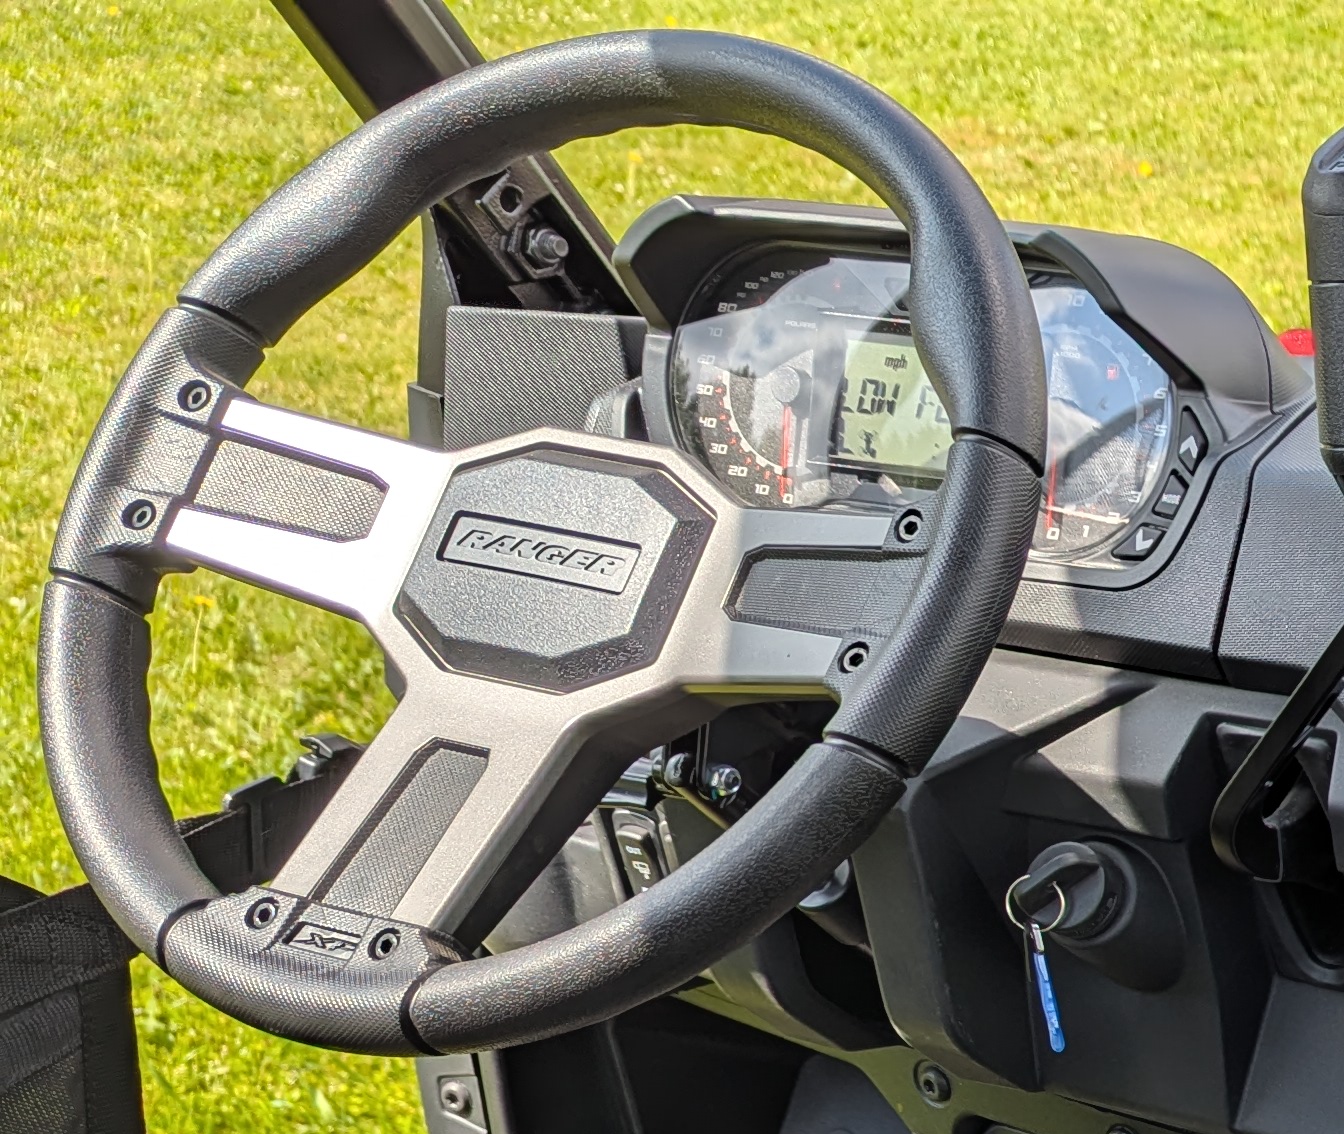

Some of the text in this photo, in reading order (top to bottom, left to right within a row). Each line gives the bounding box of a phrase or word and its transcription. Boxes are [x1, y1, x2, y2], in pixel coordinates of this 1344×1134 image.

[770, 271, 784, 279] 120
[744, 281, 760, 290] 100
[1066, 294, 1085, 307] 10
[717, 302, 737, 313] 80
[785, 320, 816, 329] POLARIS
[708, 327, 723, 337] 70
[697, 354, 715, 365] 60
[883, 353, 908, 371] mph
[696, 384, 713, 396] 50
[1153, 387, 1169, 400] 6
[699, 416, 717, 429] 40
[1154, 424, 1167, 437] 5
[709, 443, 728, 455] 30
[727, 465, 748, 477] 20
[754, 484, 770, 496] 10
[782, 493, 794, 505] 0
[1046, 527, 1060, 540] 0
[1083, 525, 1090, 538] 1
[457, 529, 627, 576] RANGER
